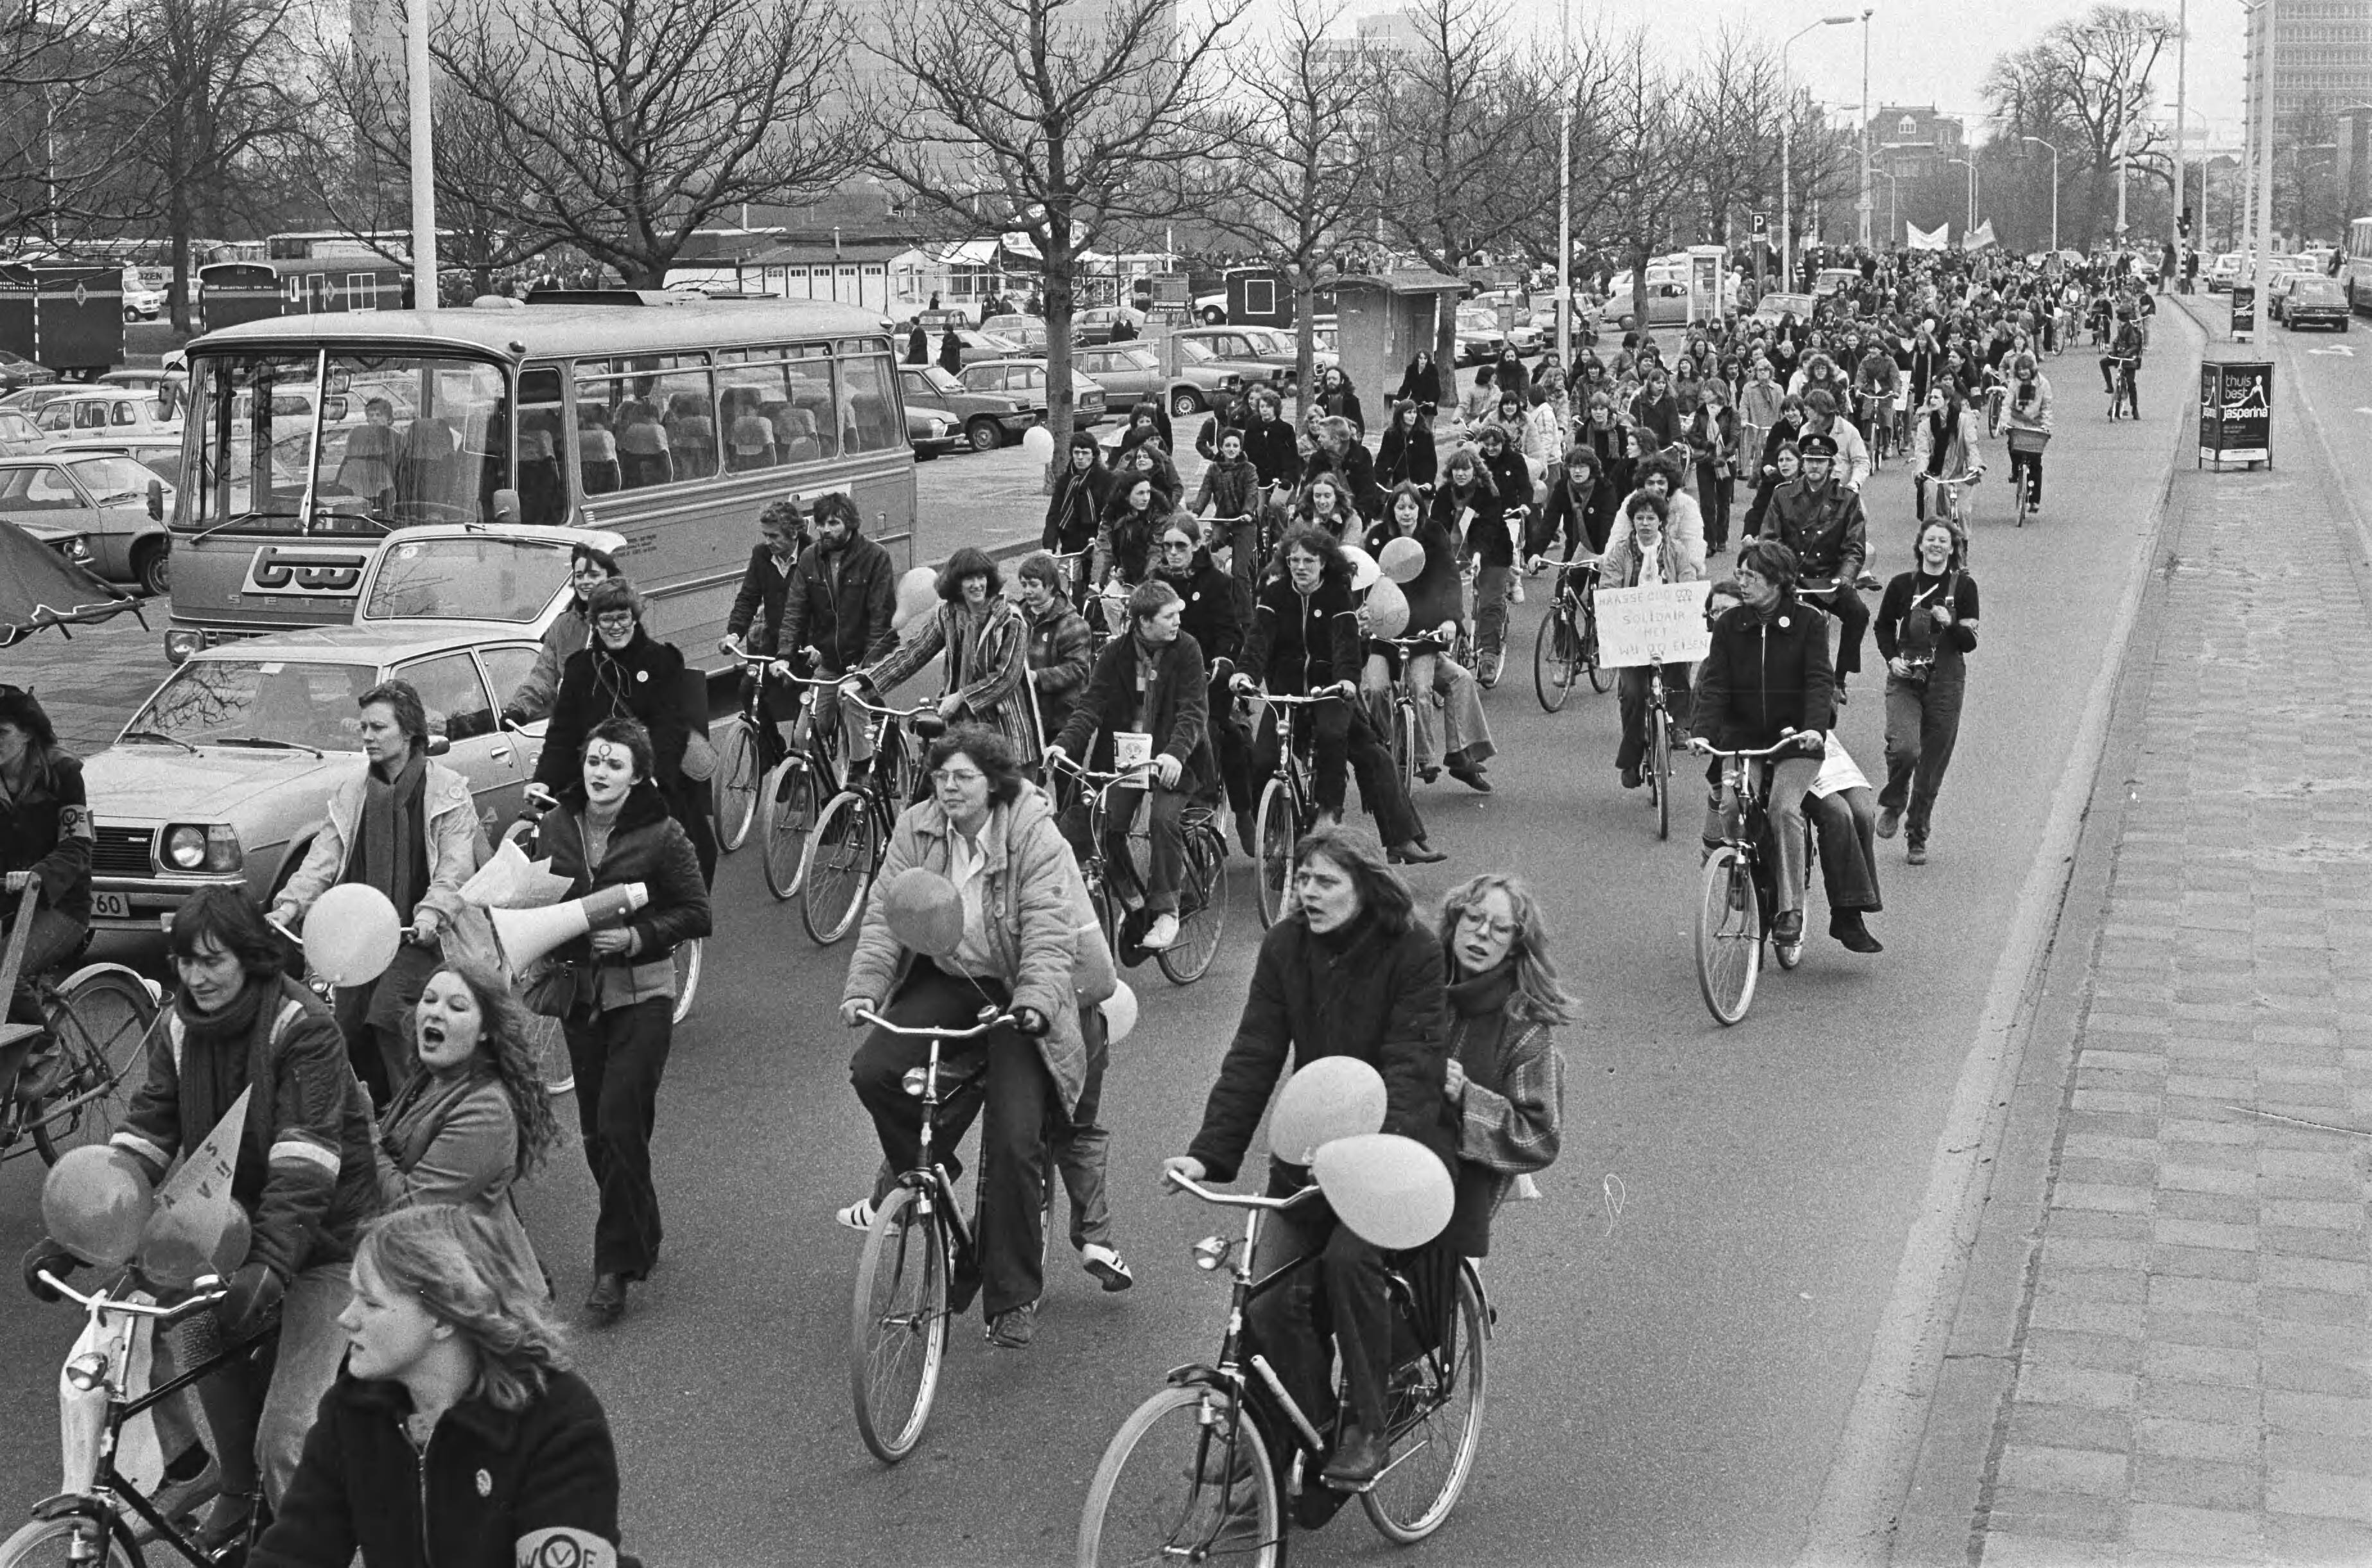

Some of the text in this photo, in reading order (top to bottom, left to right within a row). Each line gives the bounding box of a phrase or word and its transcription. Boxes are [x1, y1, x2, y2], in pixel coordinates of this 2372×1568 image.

[1754, 215, 1764, 232] P
[2226, 374, 2252, 387] thuis
[2225, 387, 2249, 399] best
[2222, 406, 2268, 422] jasperina
[228, 594, 353, 607] SETR
